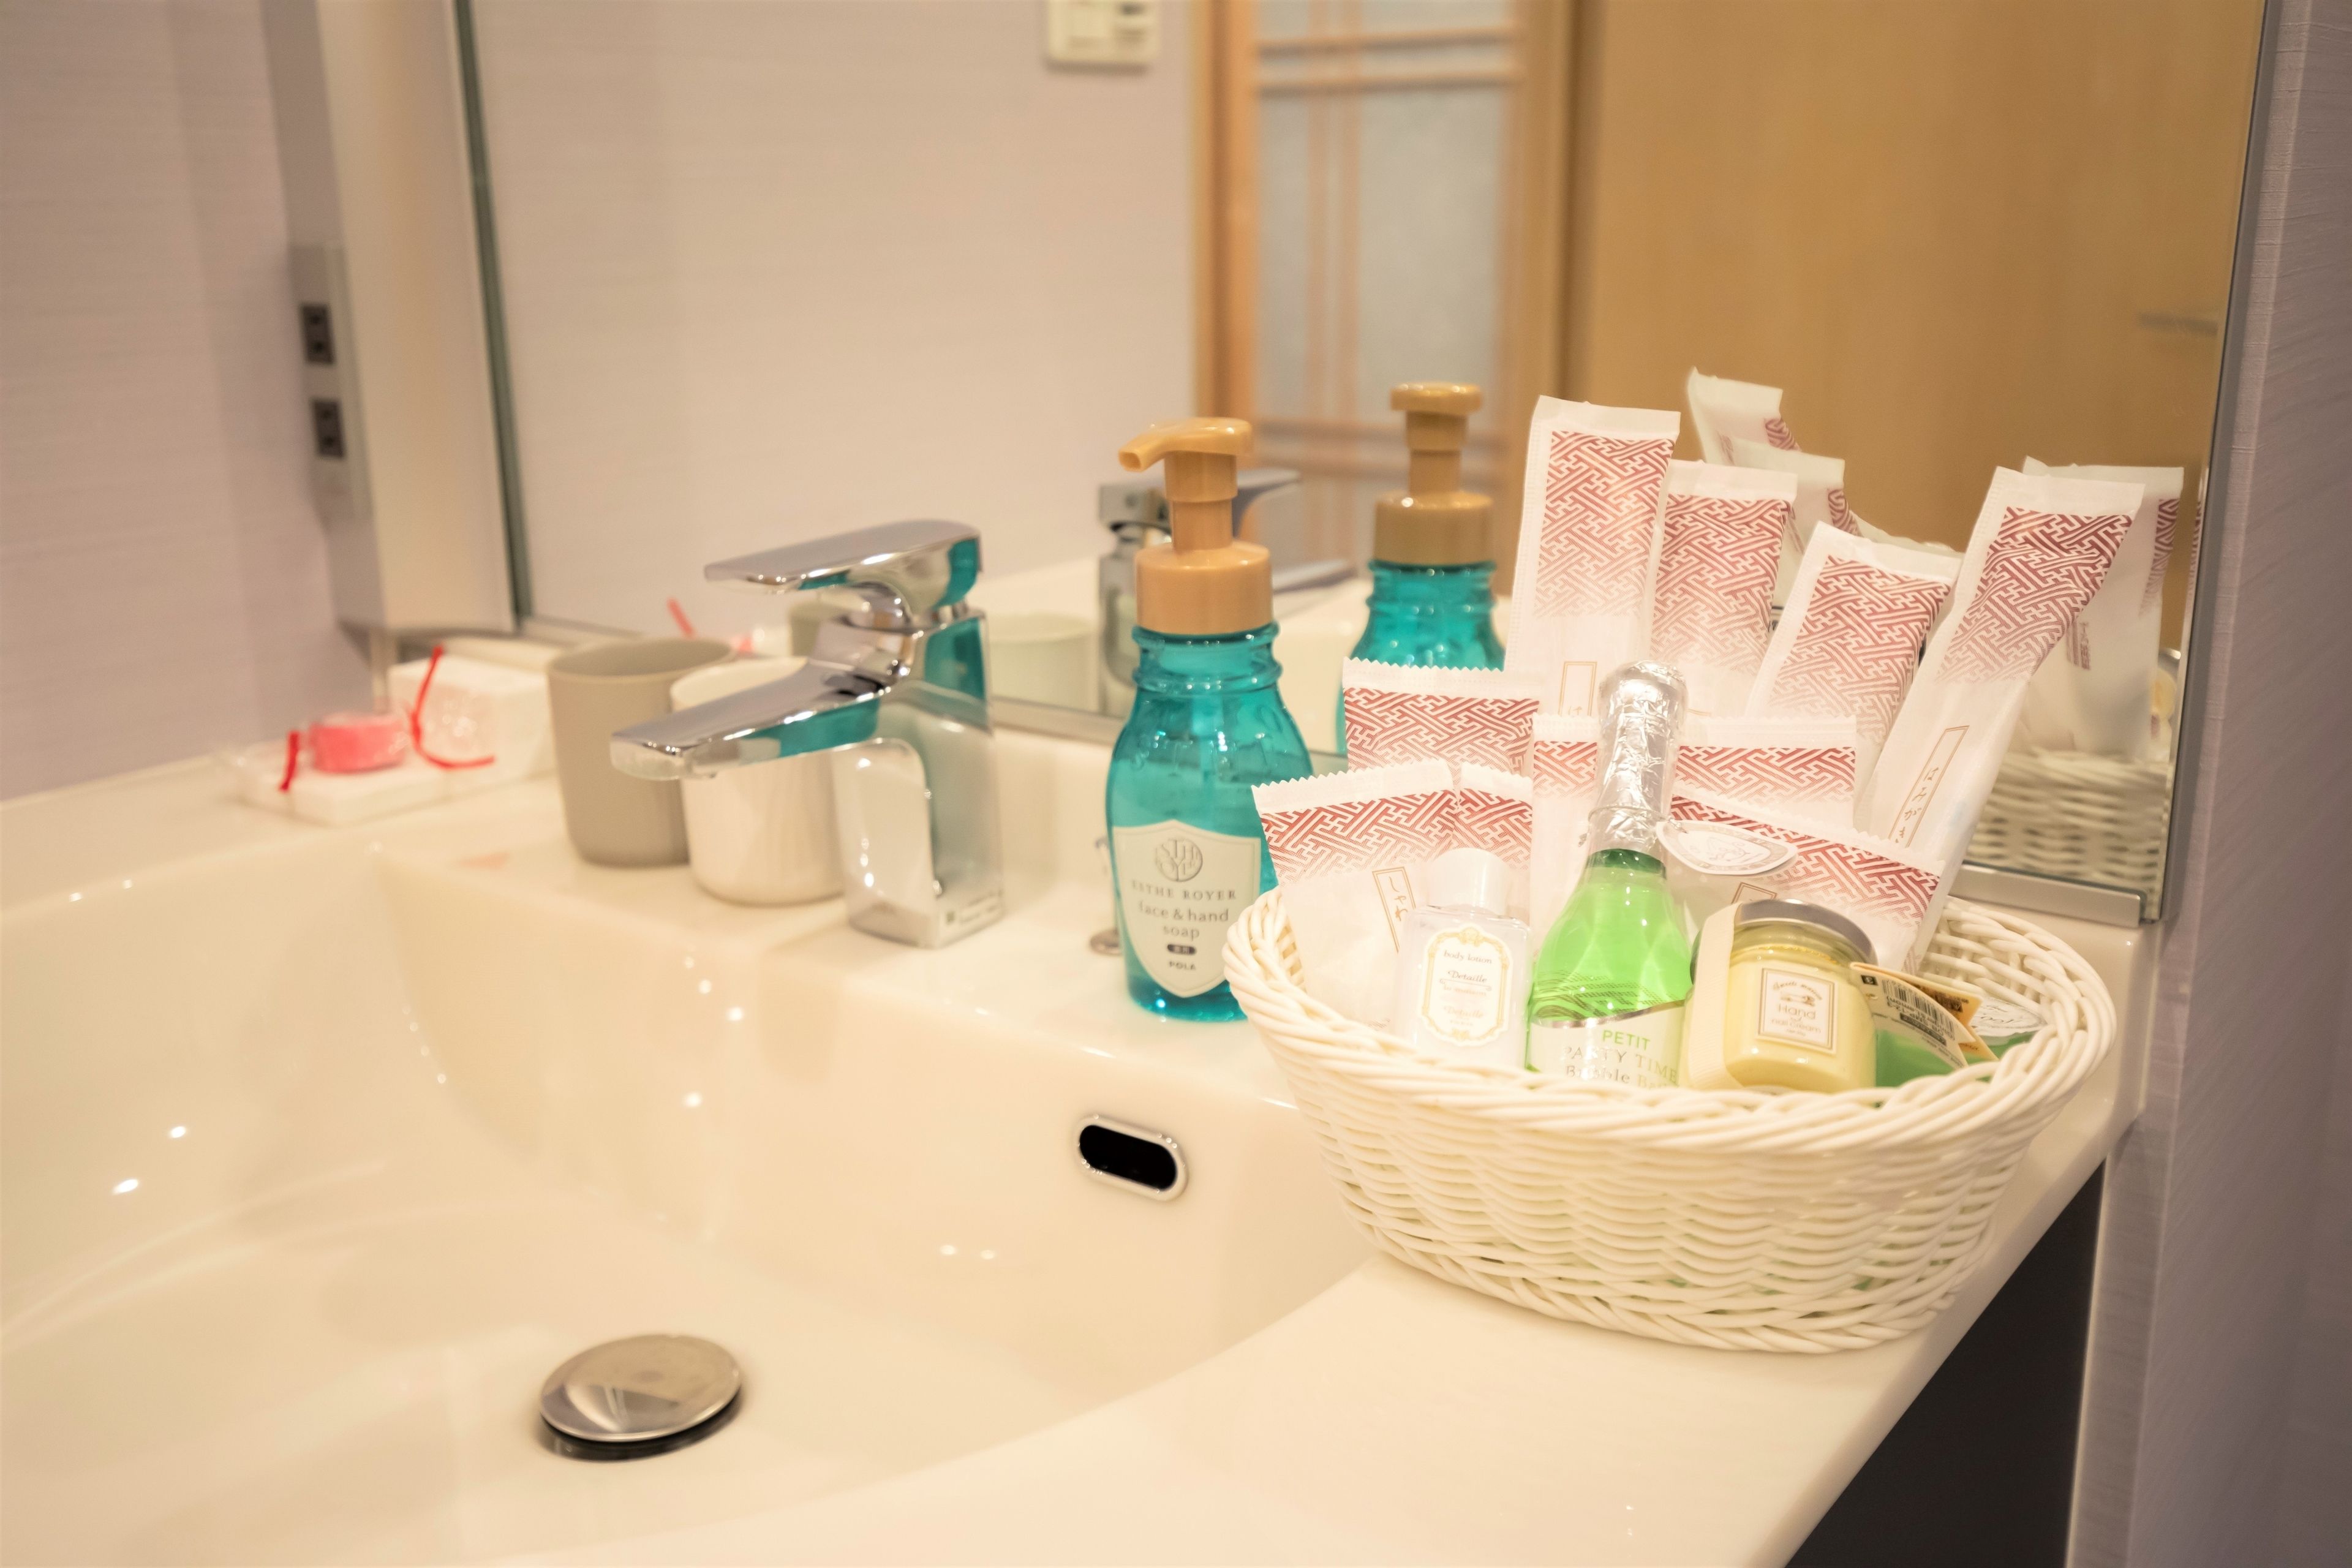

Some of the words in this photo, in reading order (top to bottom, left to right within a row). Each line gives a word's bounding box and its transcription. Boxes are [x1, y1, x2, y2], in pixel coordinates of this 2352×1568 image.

[1133, 880, 1174, 897] ESTHE
[1182, 889, 1237, 901] ROYER
[1139, 900, 1168, 916] face
[1173, 907, 1183, 921] &
[1188, 908, 1229, 922] hand
[1163, 925, 1200, 941] soap
[1444, 949, 1464, 961] body
[1467, 953, 1492, 964] lotion
[1169, 961, 1196, 971] POLA
[1779, 1004, 1815, 1019] Hand
[1602, 1030, 1651, 1051] PETIT
[1636, 1054, 1678, 1085] TIME
